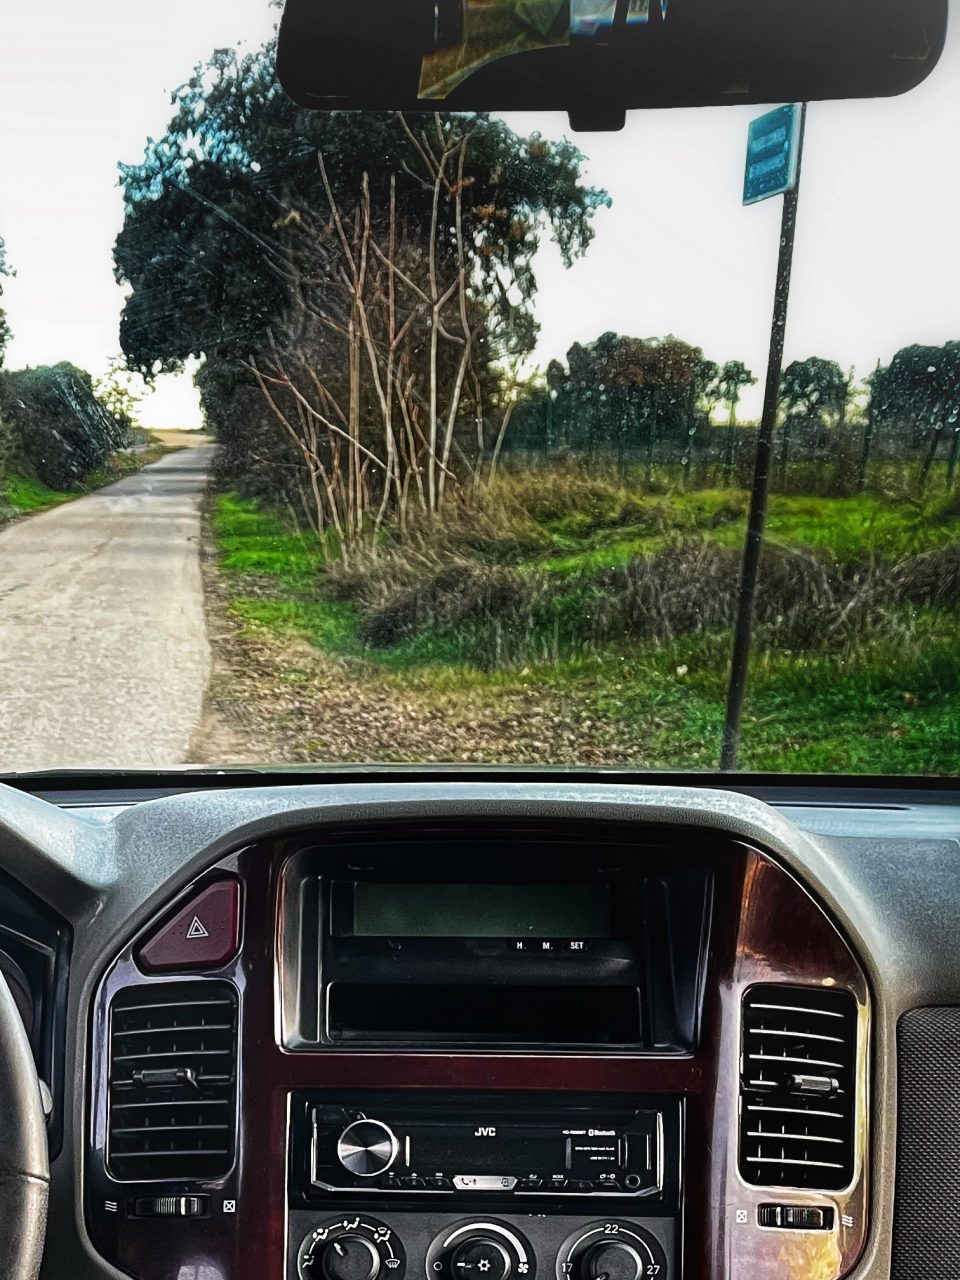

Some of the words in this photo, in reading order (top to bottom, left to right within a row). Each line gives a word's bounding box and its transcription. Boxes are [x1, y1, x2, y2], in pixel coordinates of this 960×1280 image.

[570, 941, 585, 950] SET
[474, 1127, 496, 1137] JVC
[604, 1224, 619, 1234] 22
[561, 1263, 573, 1273] 17
[646, 1265, 660, 1275] 27
